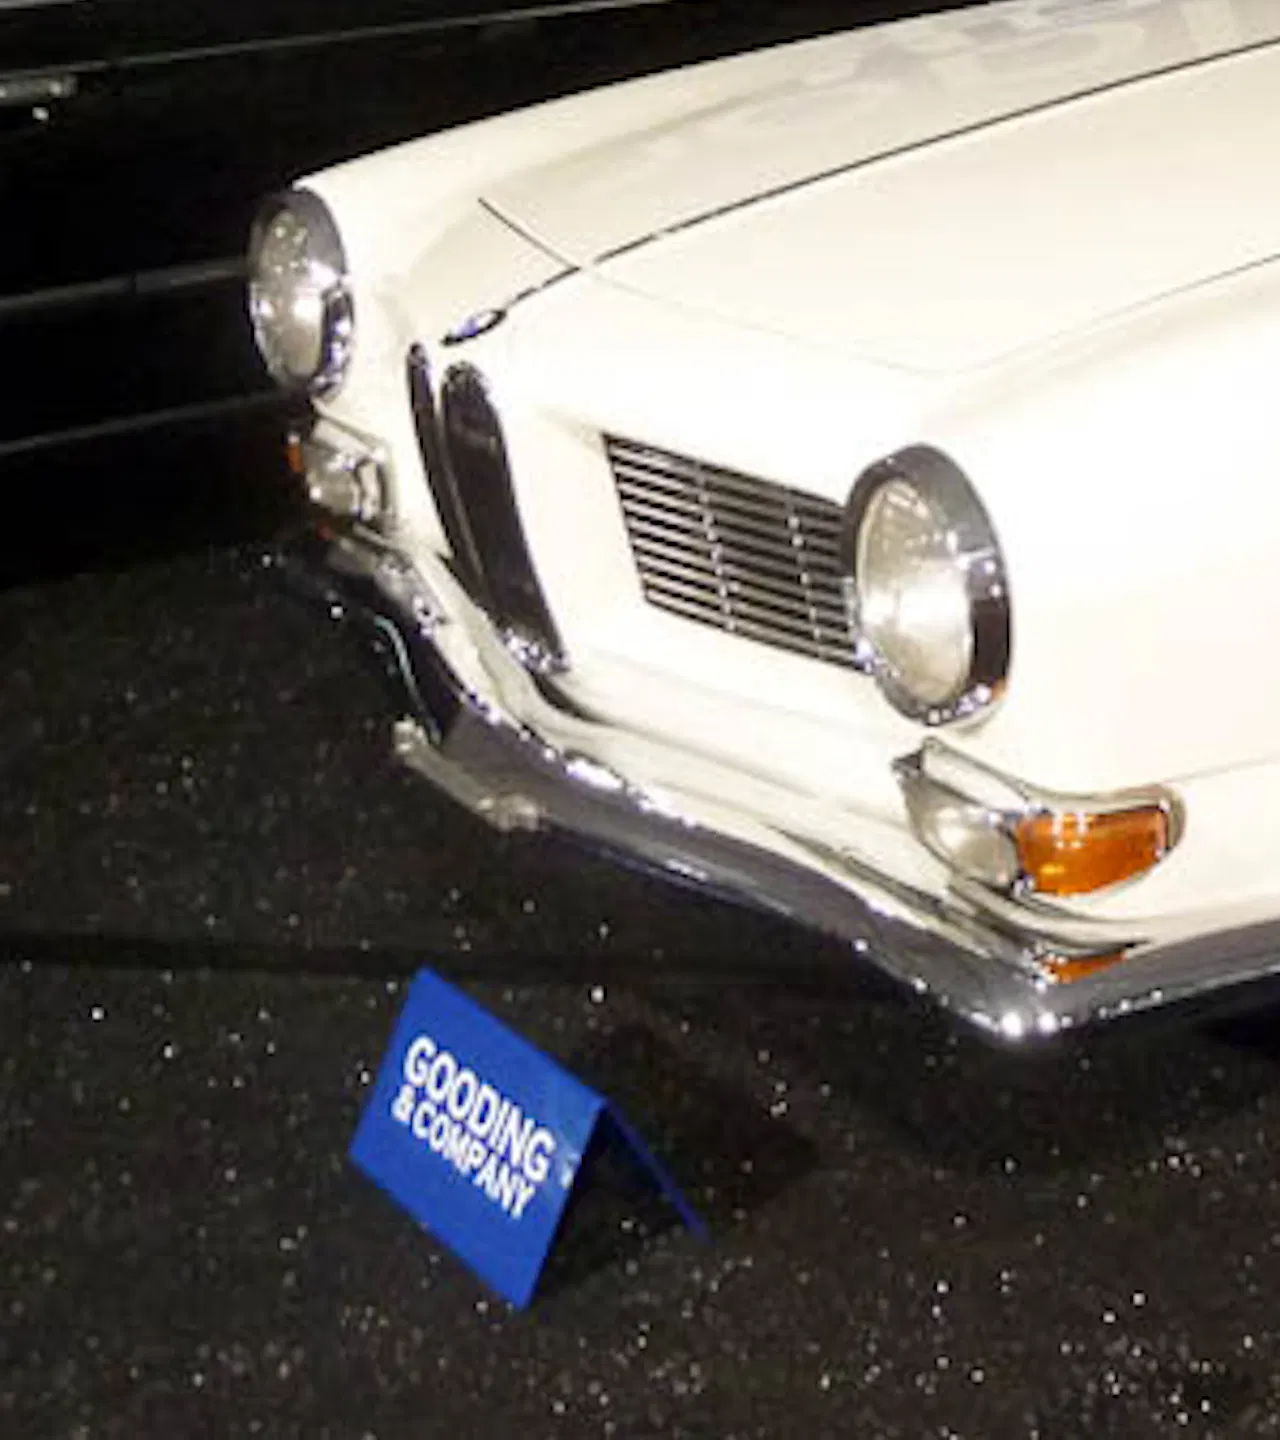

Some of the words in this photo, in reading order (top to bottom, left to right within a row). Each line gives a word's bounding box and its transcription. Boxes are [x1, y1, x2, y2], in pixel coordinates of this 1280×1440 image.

[391, 1083, 415, 1124] &
[413, 1101, 536, 1219] COMPANY
[405, 1035, 554, 1183] GOODING
